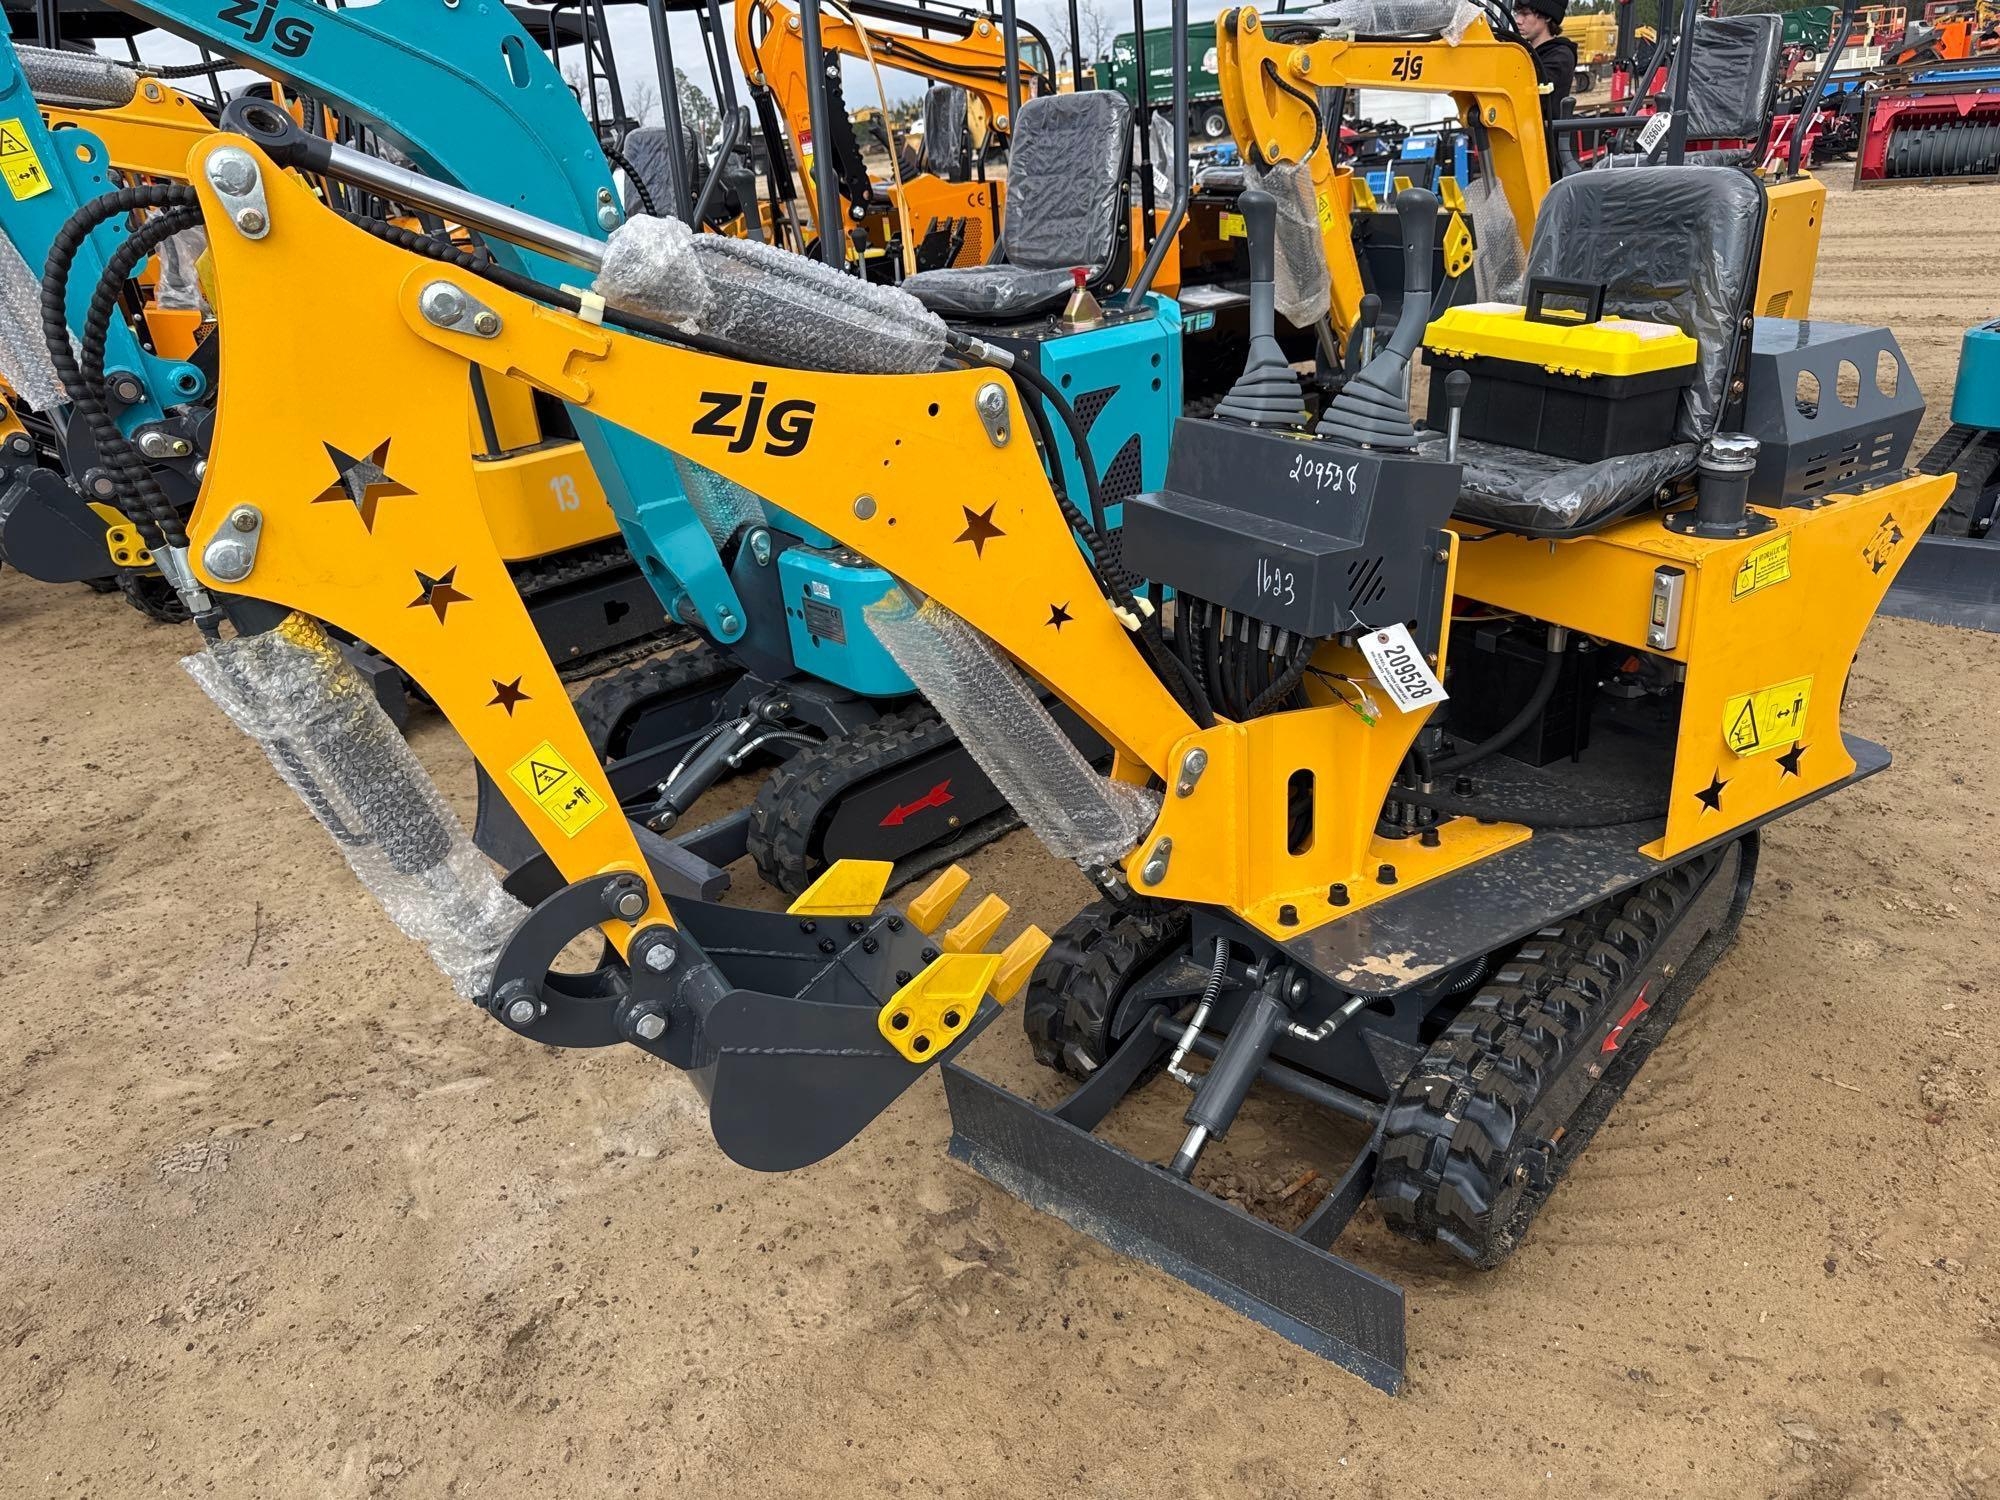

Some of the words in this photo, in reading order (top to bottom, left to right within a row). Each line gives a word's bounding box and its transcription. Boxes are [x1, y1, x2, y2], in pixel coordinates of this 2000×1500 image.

[217, 0, 315, 57] zjg
[1391, 50, 1423, 81] zjg
[968, 192, 985, 207] CE
[691, 381, 817, 457] zjg
[550, 475, 579, 511] 13
[1289, 454, 1359, 494] 209528
[1258, 558, 1295, 606] 1623
[1384, 645, 1432, 699] 209528
